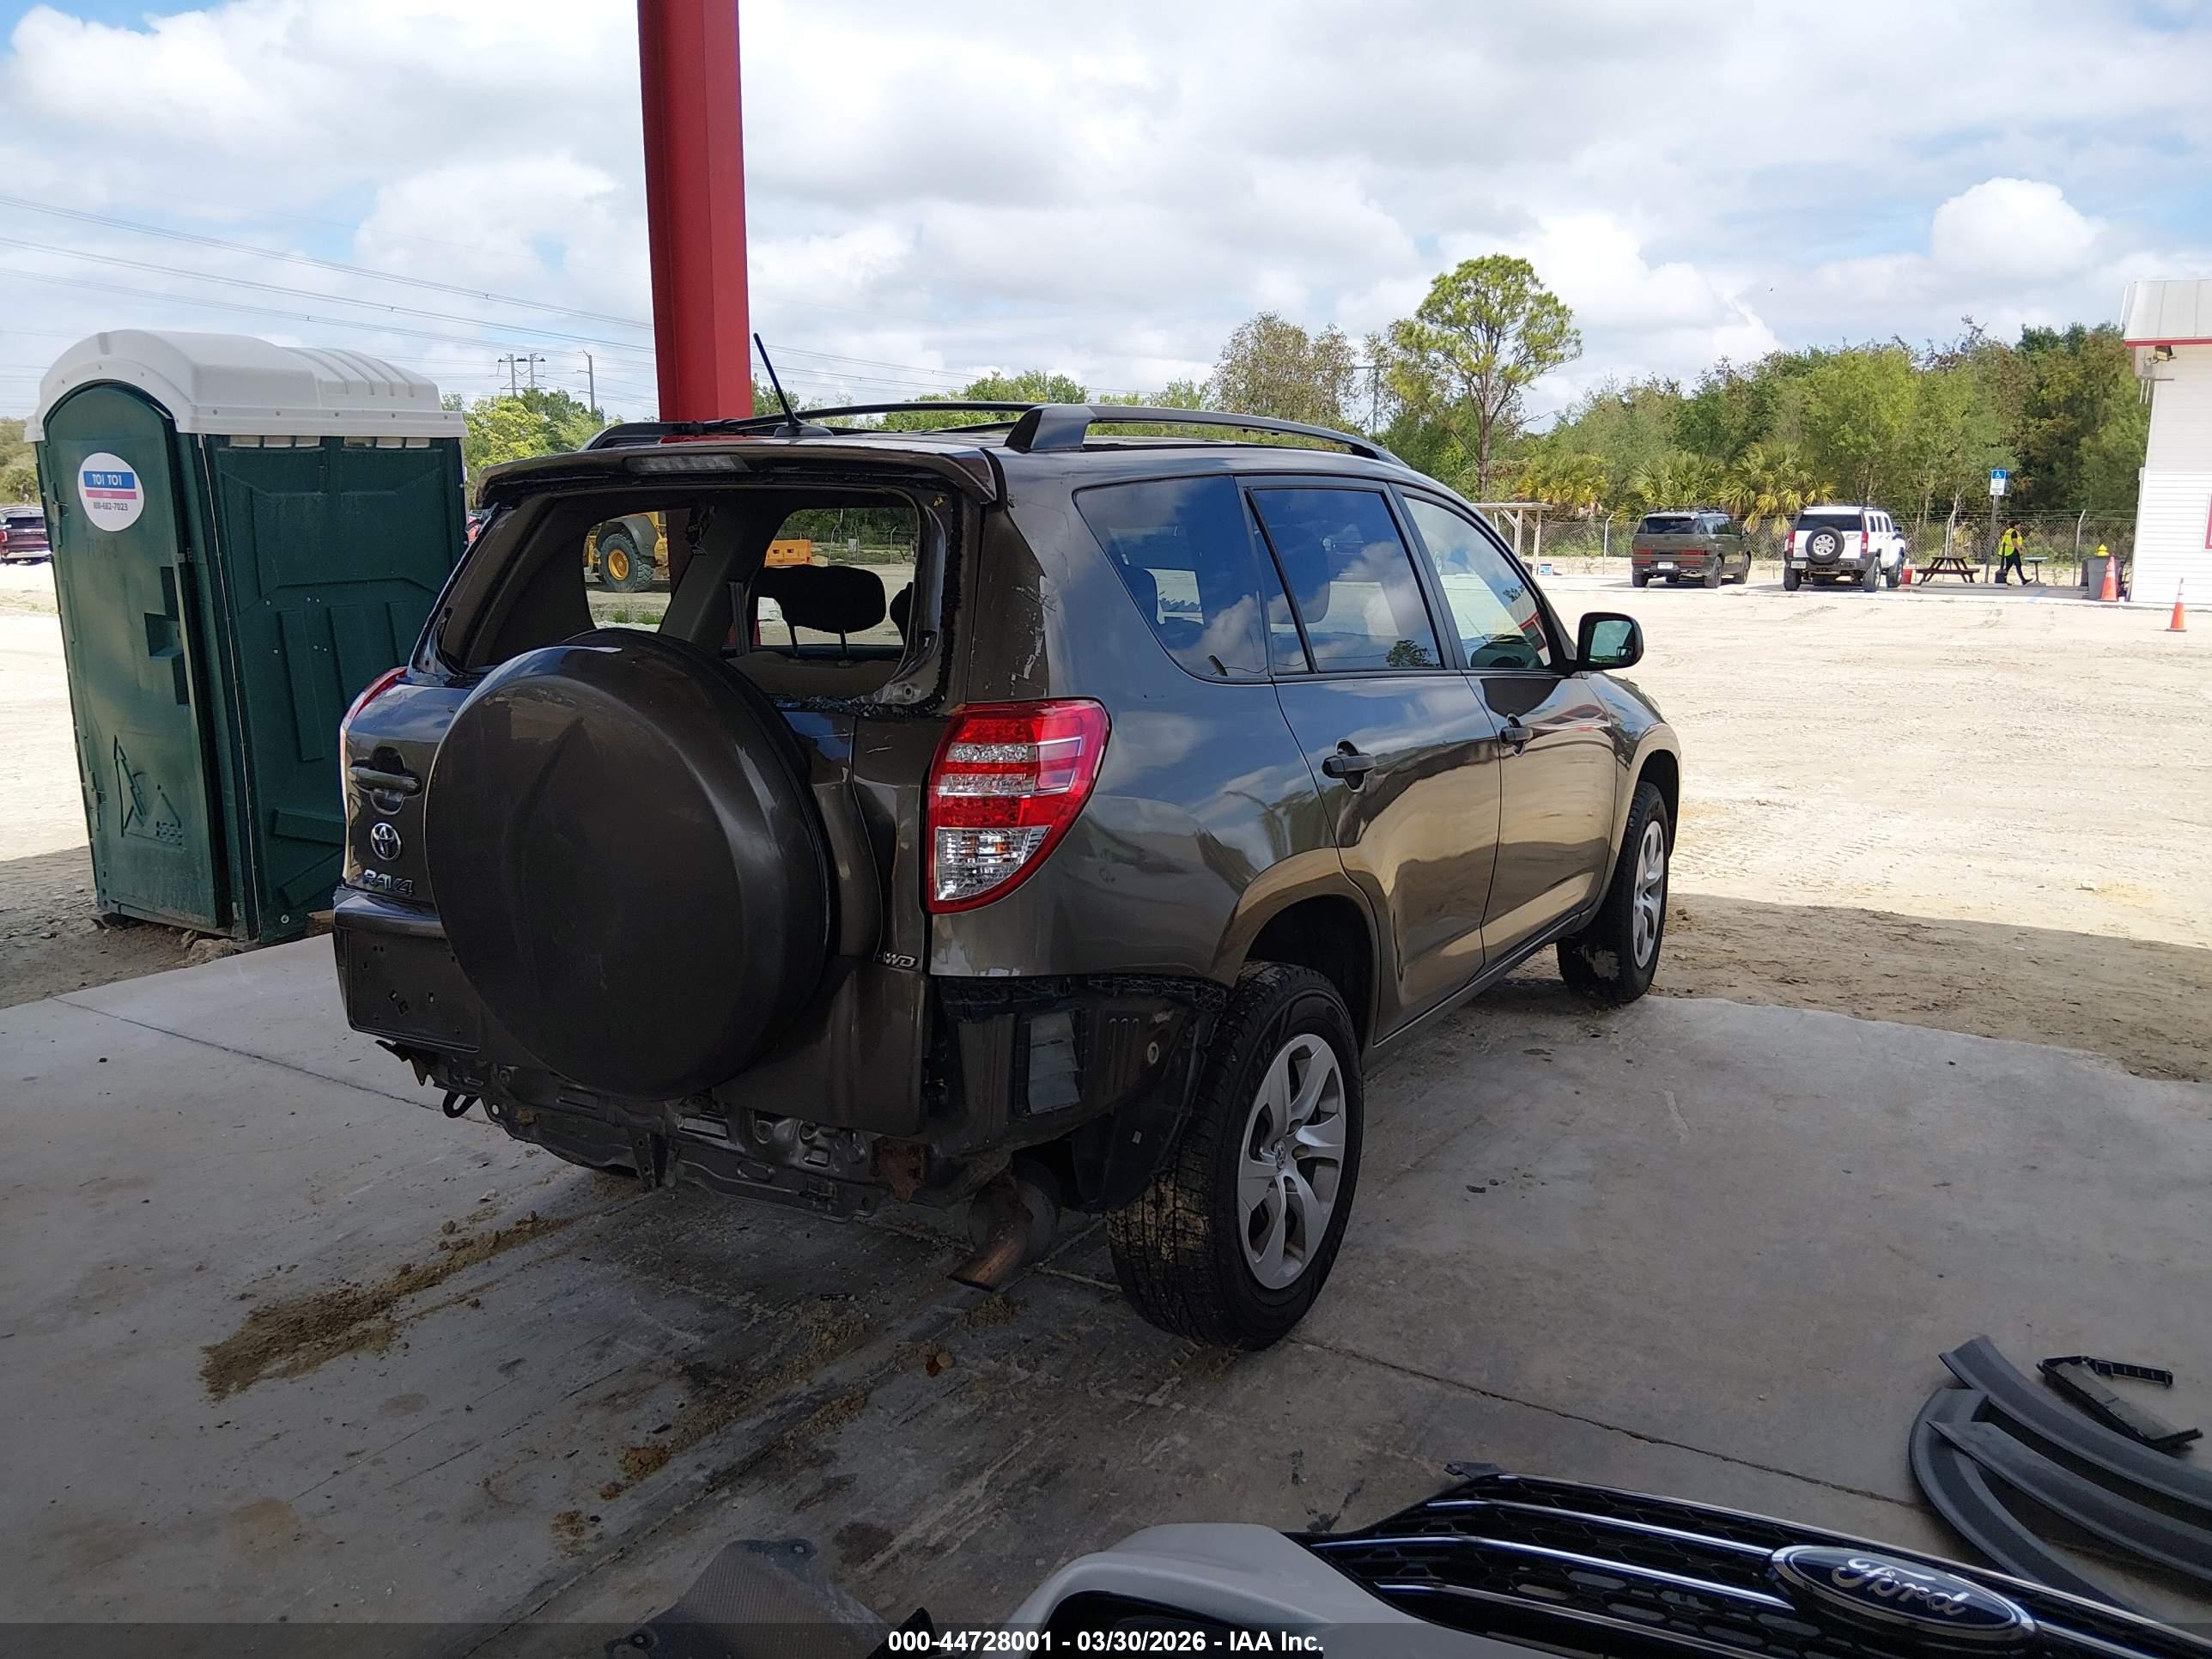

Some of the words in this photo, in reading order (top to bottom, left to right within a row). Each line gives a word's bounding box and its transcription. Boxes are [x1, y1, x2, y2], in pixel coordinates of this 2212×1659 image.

[92, 473, 104, 486] TOI
[107, 474, 122, 486] TOI
[93, 501, 129, 511] -682-7023
[364, 869, 413, 894] RAV4
[884, 951, 915, 968] WD
[1831, 1557, 1971, 1617] Ford
